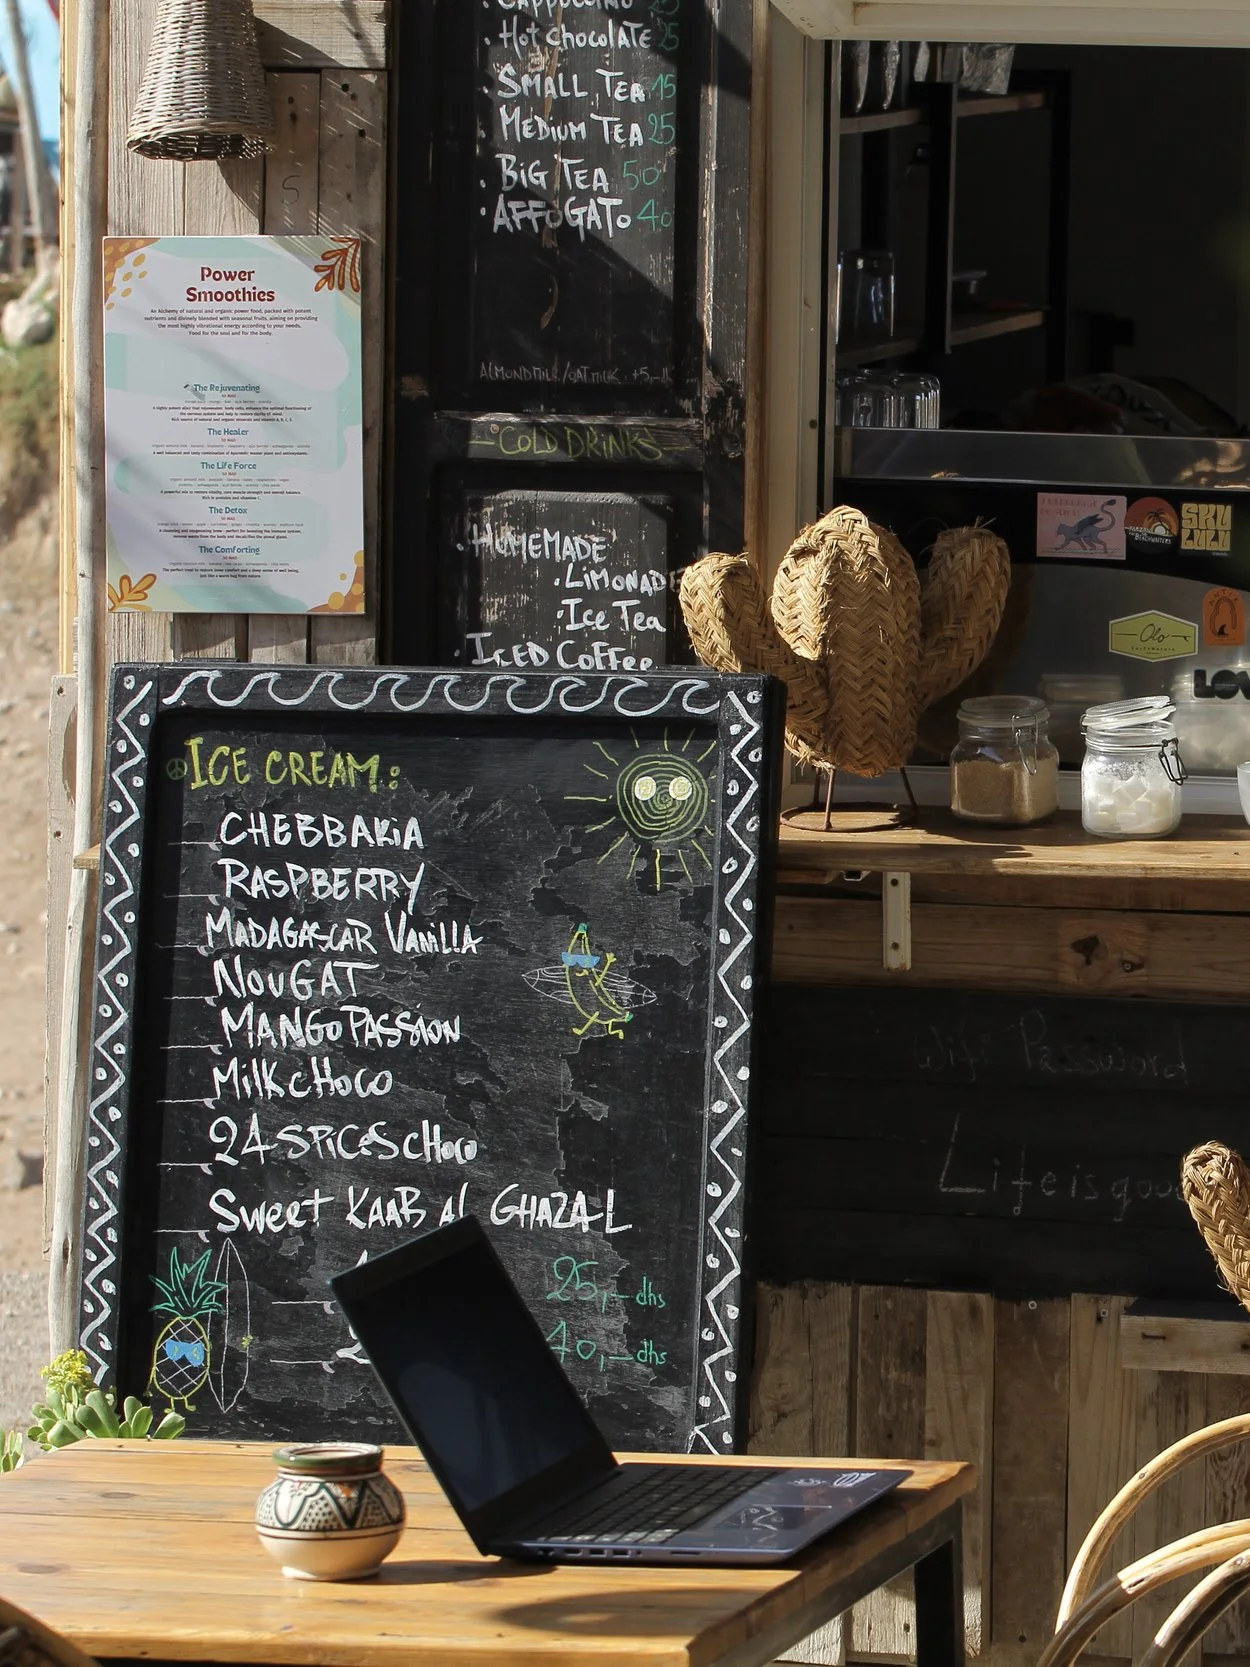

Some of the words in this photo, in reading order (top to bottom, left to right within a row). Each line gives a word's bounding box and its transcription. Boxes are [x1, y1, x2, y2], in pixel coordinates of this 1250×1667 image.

[497, 62, 588, 99] SMALL
[595, 68, 646, 103] TEA
[590, 112, 645, 147] TEA
[648, 112, 676, 145] 25
[554, 153, 610, 194] TEA
[622, 160, 660, 191] 50
[635, 198, 673, 232] 40
[199, 265, 256, 282] Power
[186, 285, 276, 302] Smoothies
[193, 384, 208, 392] The
[209, 383, 261, 394] Rejuvenating
[207, 428, 222, 436] The
[223, 428, 249, 436] Healer
[498, 425, 558, 455] COLD
[200, 462, 215, 470] The
[216, 462, 232, 470] Life
[234, 462, 257, 470] Force
[209, 506, 223, 514] The
[224, 506, 248, 515] Detox
[199, 546, 213, 554] The
[214, 546, 261, 556] Comforting
[471, 523, 607, 564] HOMEMADE
[184, 736, 250, 790] ICE
[216, 857, 426, 916] RASPBERRY
[205, 906, 378, 955] MADAGASCAR
[212, 954, 381, 1001] NOUGAT
[209, 1188, 335, 1234] Sweet
